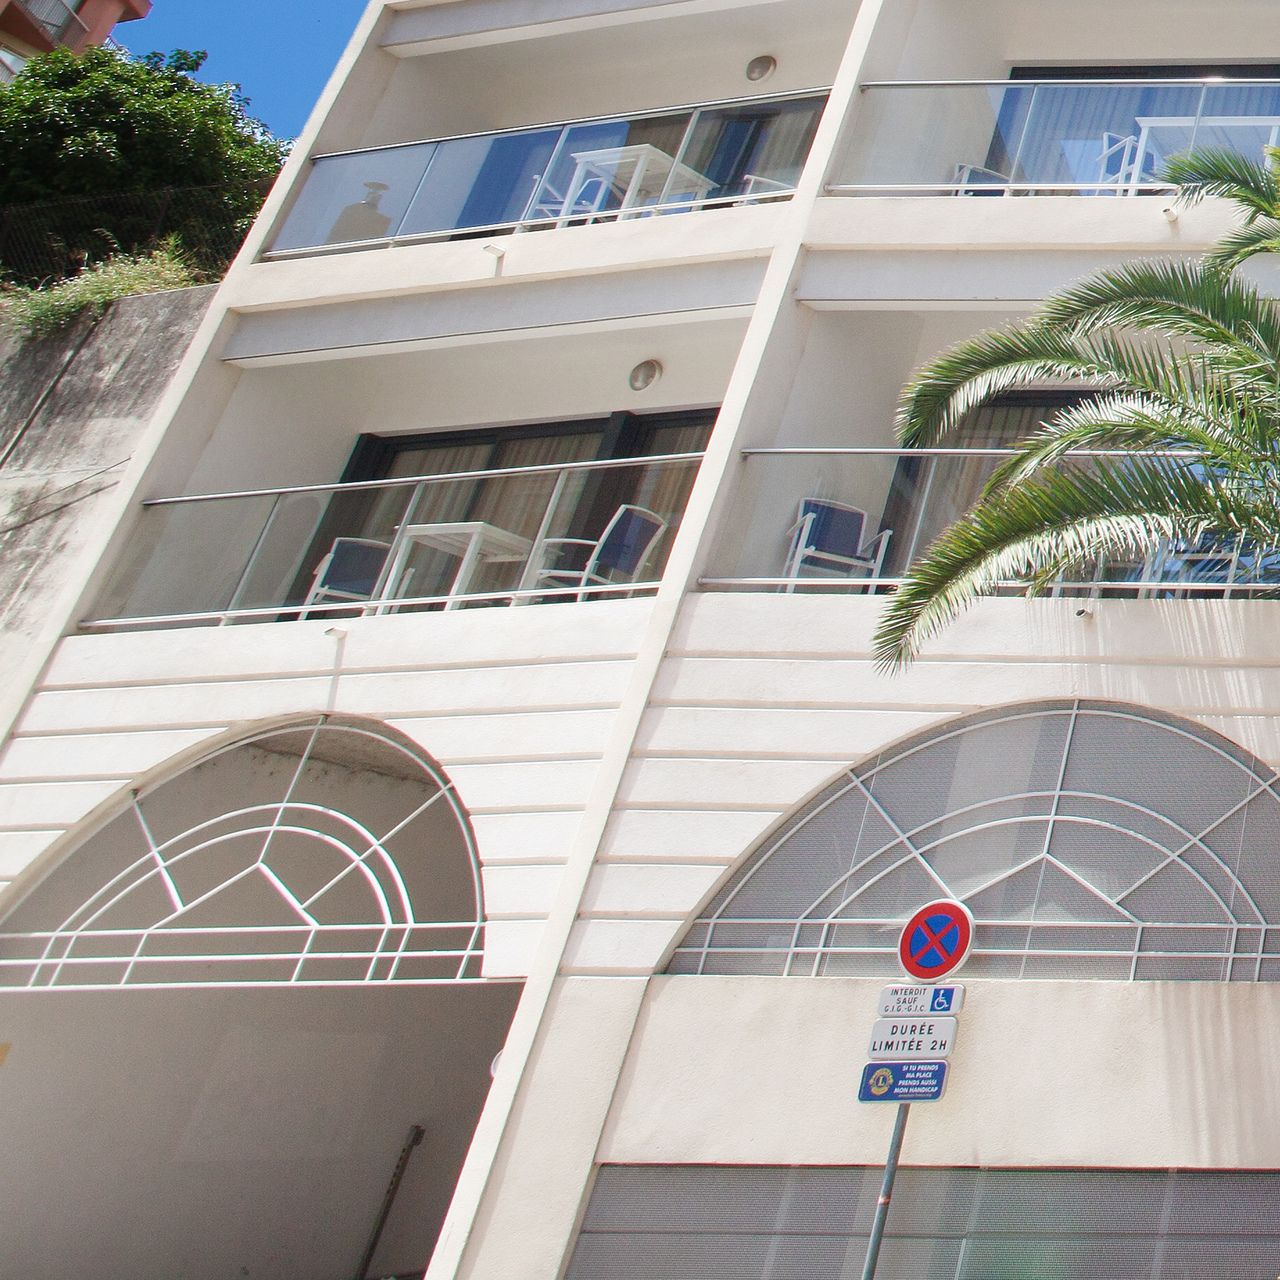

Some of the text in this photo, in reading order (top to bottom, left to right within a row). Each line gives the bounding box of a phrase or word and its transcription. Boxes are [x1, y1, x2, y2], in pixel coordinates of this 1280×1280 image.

[890, 988, 927, 996] INTERDIT
[896, 997, 918, 1005] SAUF
[890, 1022, 935, 1036] DURÉE
[871, 1037, 948, 1052] LIMITÉE 2H
